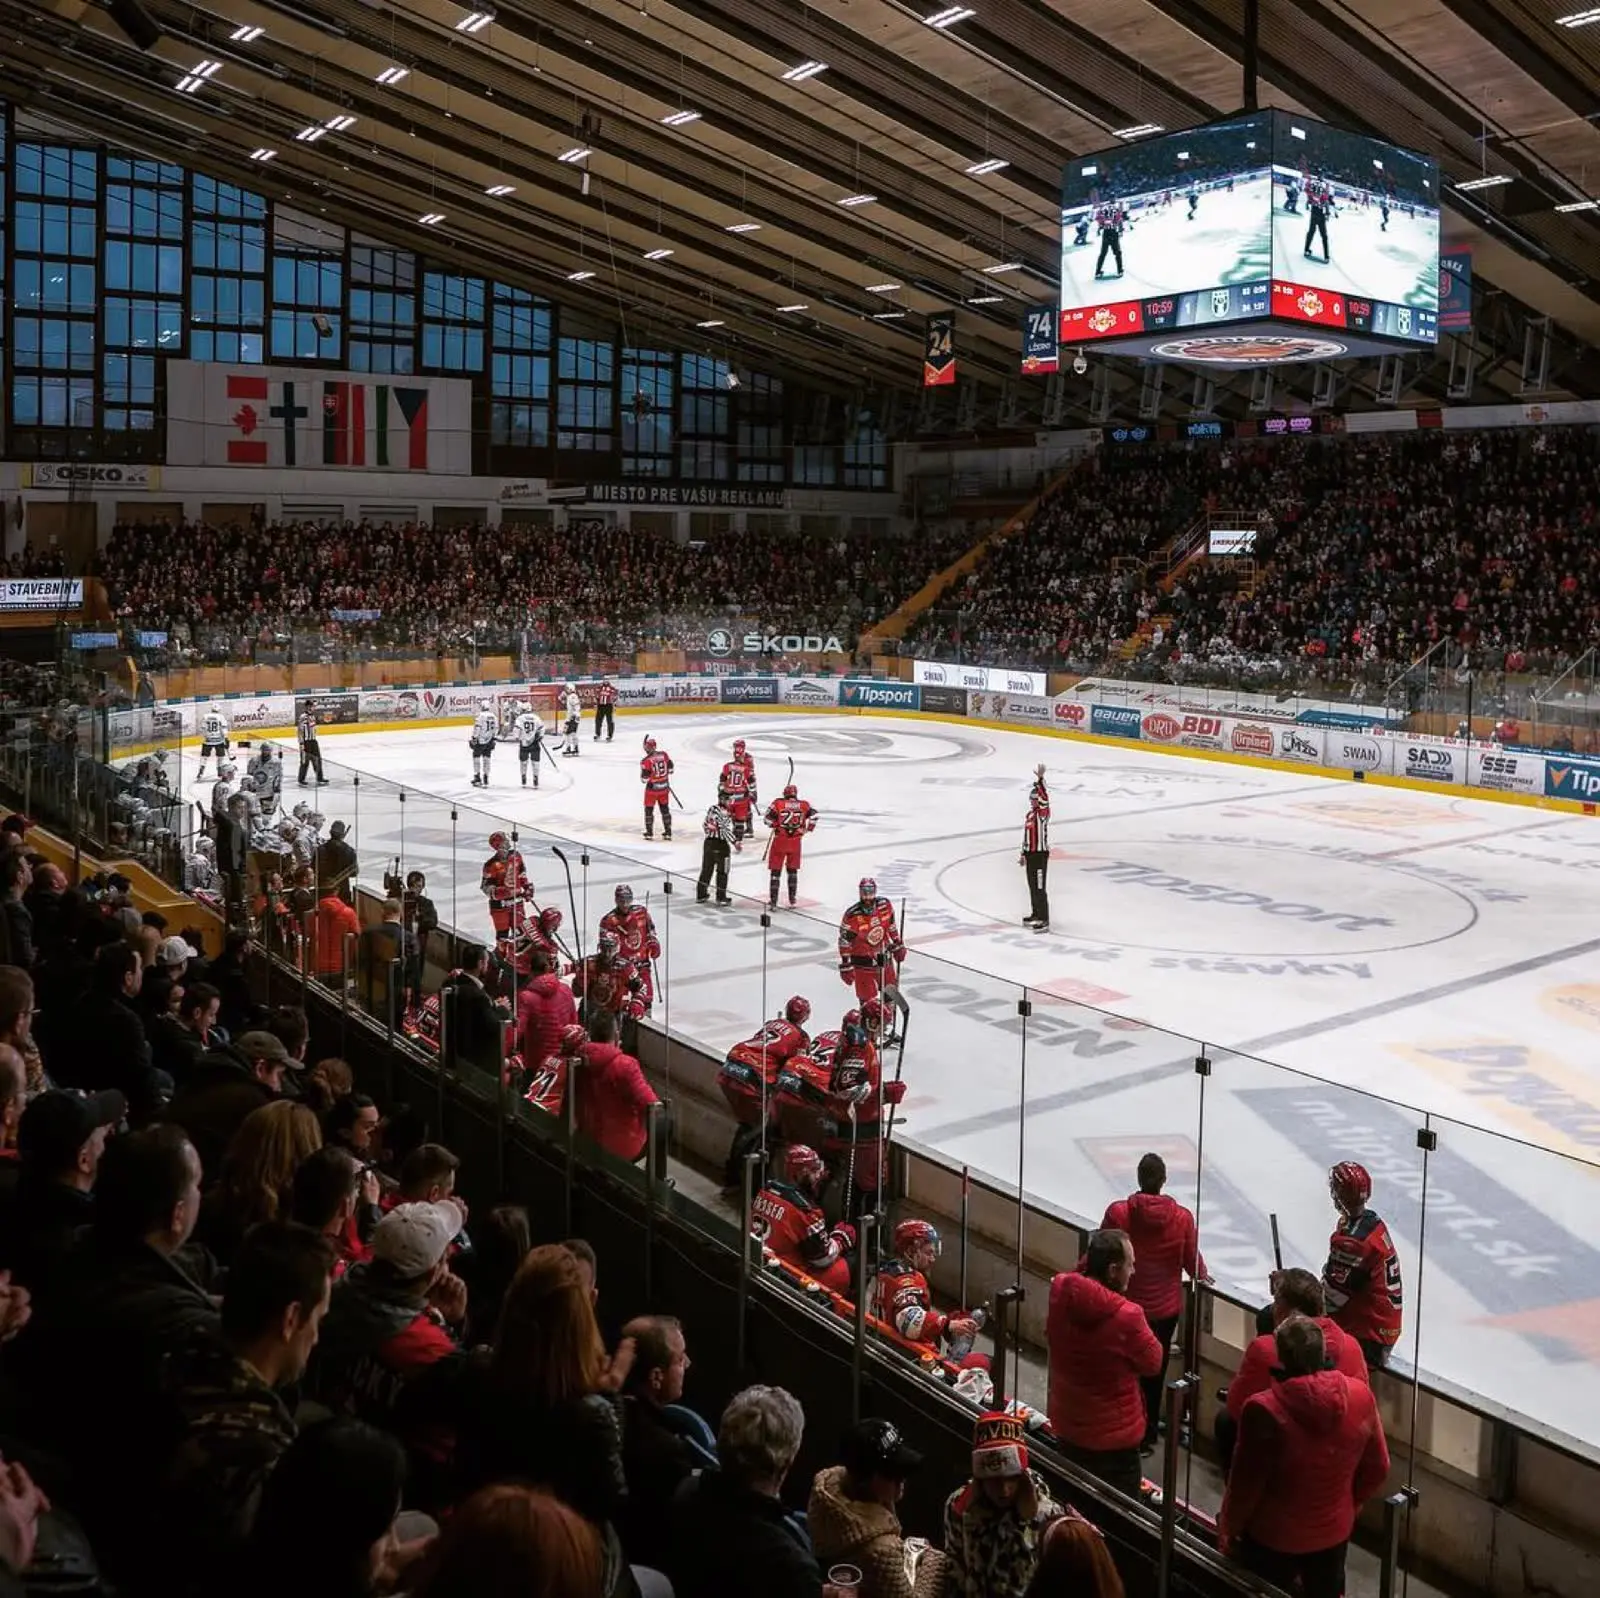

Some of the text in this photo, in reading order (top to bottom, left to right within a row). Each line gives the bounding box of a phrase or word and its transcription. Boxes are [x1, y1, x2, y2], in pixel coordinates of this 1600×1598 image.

[1147, 301, 1173, 316] 10:59
[56, 466, 123, 481] OSKO
[592, 485, 786, 505] MIESTO PRE VAŠU REKLAMU
[9, 581, 79, 596] STAVEBNINY
[743, 631, 844, 654] ŠKODA
[924, 670, 1031, 692] SWAN SWAN SWAN
[858, 686, 913, 704] Tipsport
[1343, 745, 1376, 762] SWAN
[1080, 860, 1396, 932] Tipsport
